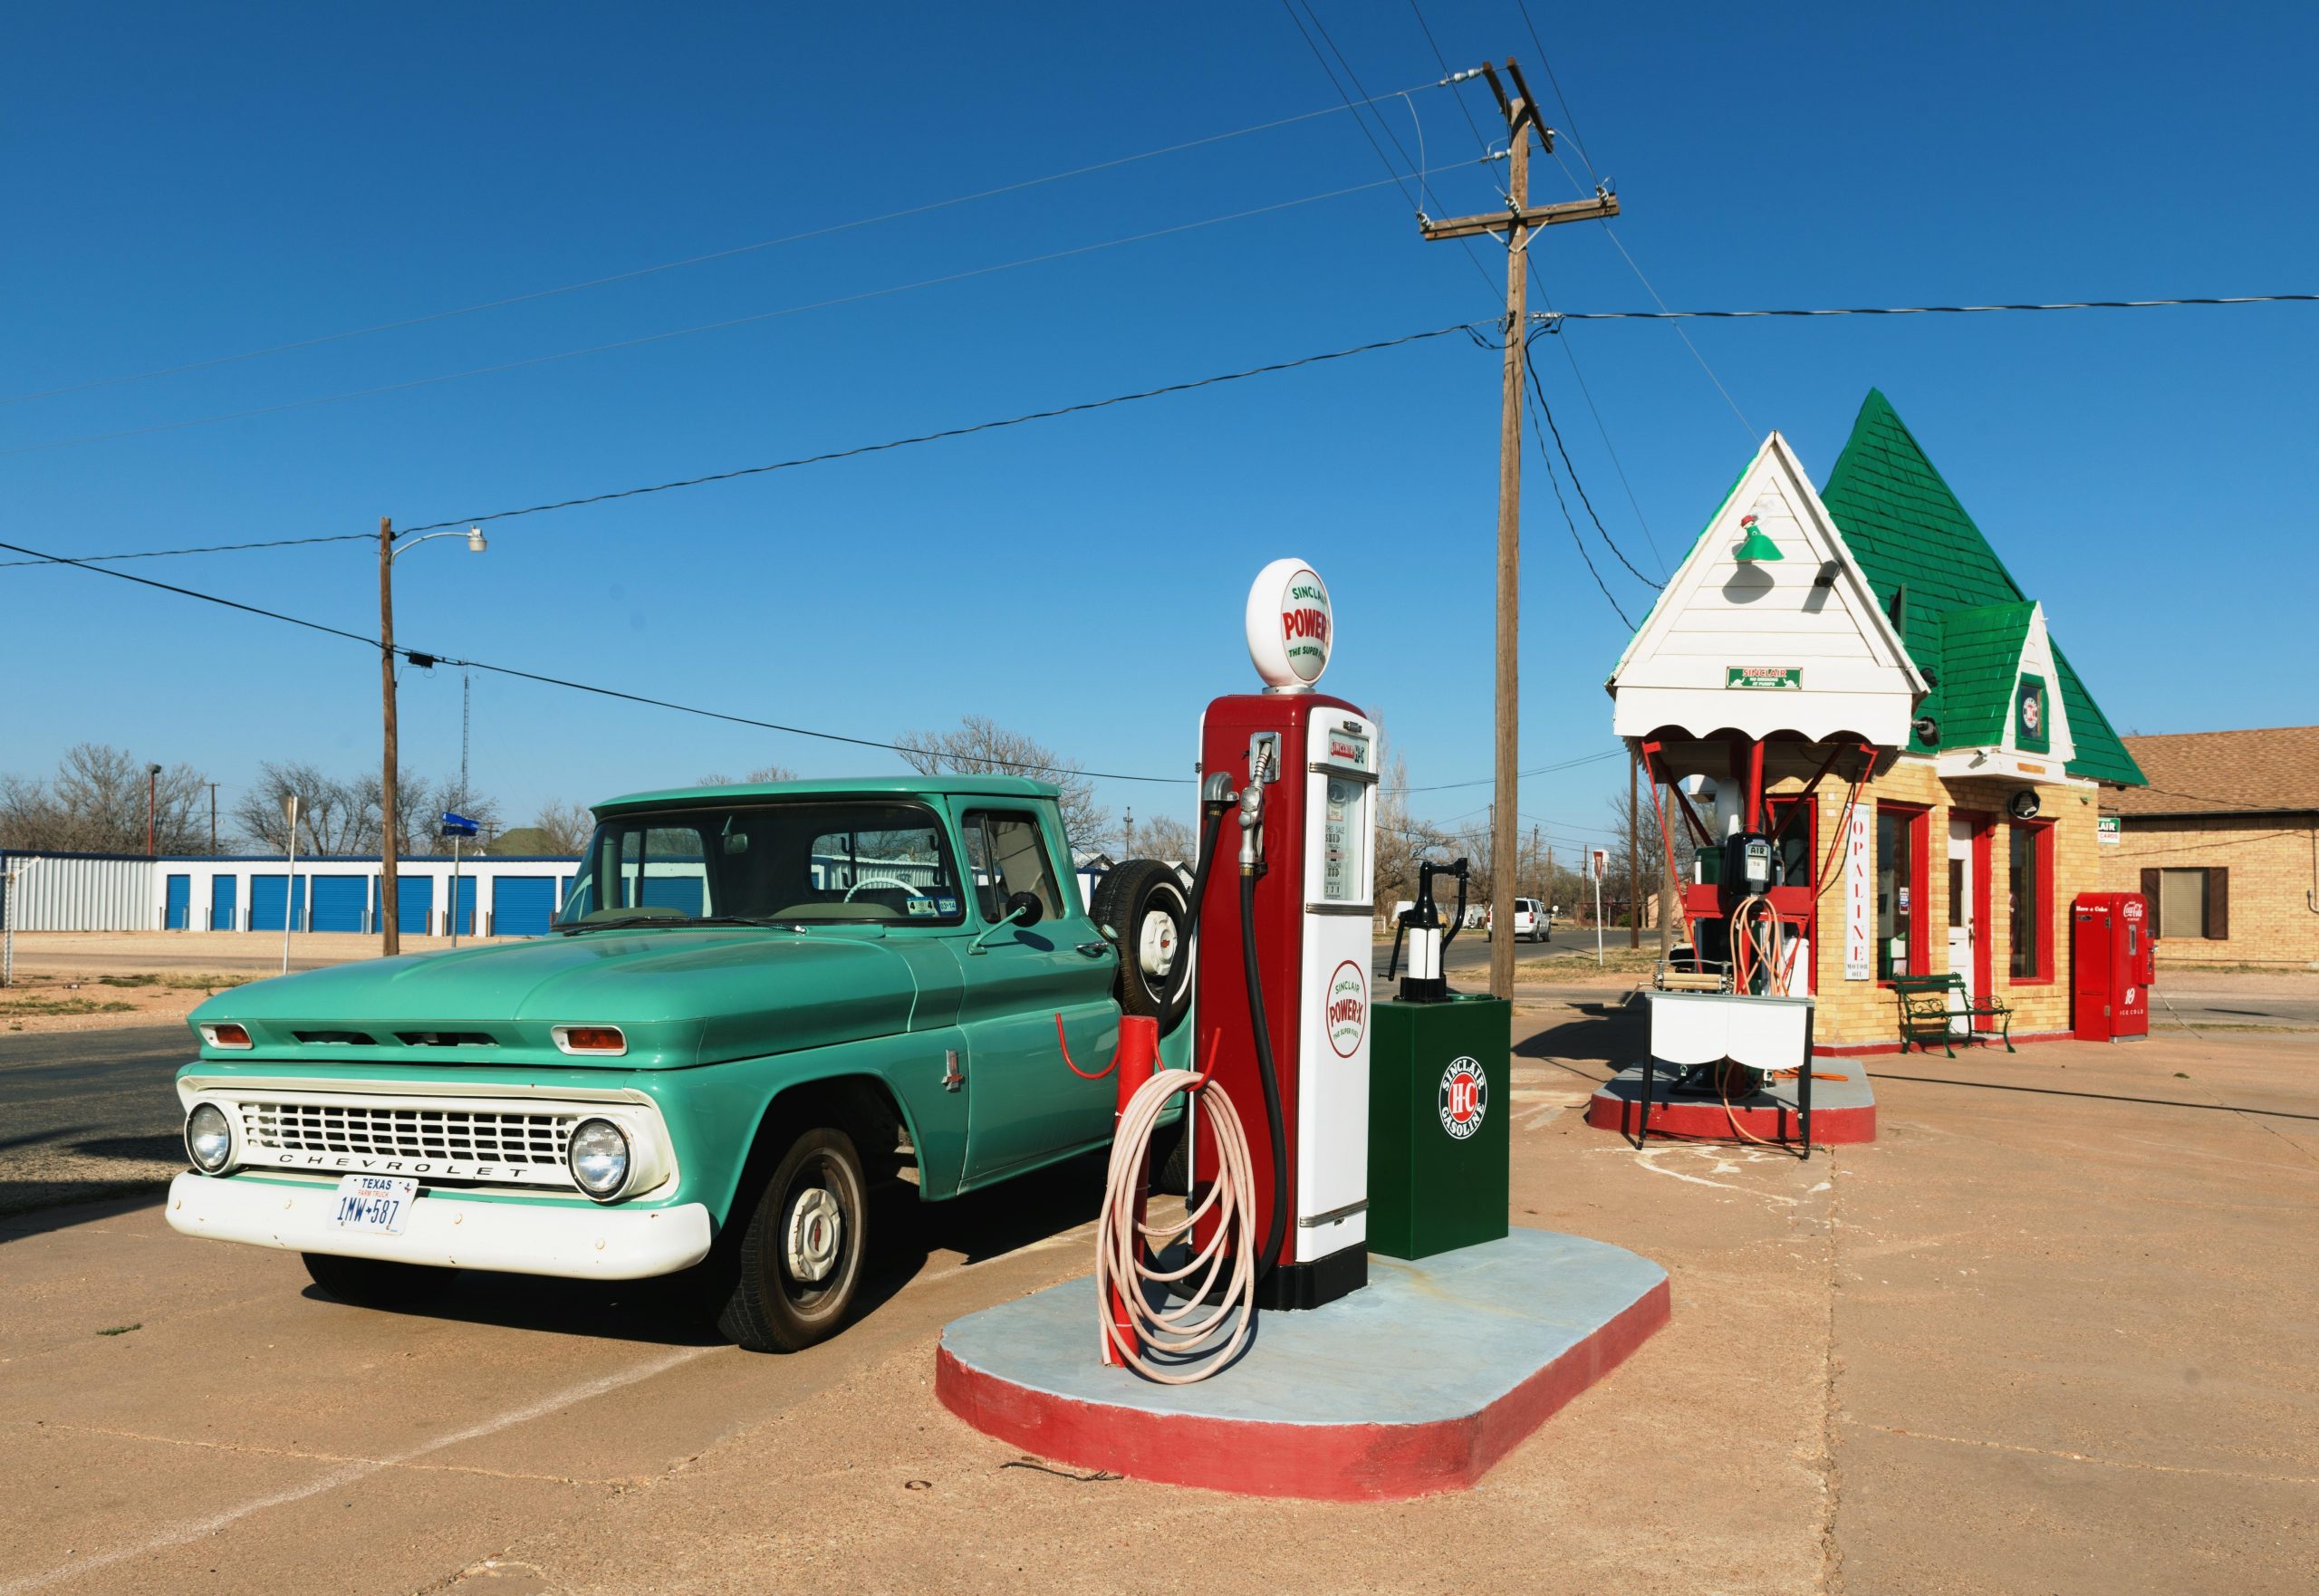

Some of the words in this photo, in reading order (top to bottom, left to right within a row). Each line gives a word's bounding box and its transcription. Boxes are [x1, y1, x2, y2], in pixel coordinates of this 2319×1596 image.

[1288, 647, 1302, 658] THE
[1302, 645, 1319, 657] SUPER
[1742, 668, 1787, 678] SINCLAIR
[1330, 738, 1355, 757] SINCLAIR
[1750, 847, 1765, 855] AIR
[1852, 820, 1864, 961] OPALINE
[928, 901, 932, 909] 4
[1334, 980, 1361, 995] SINCLAIR
[1333, 1030, 1341, 1040] THE
[1340, 1027, 1352, 1036] SUPER
[1351, 1028, 1359, 1039] FUEL
[1442, 1059, 1485, 1092] SINCLAIR
[1441, 1102, 1485, 1137] GASOLINE
[278, 1153, 528, 1178] CHEVROLET
[362, 1178, 392, 1190] TEXAS
[372, 1190, 390, 1198] TRUCK
